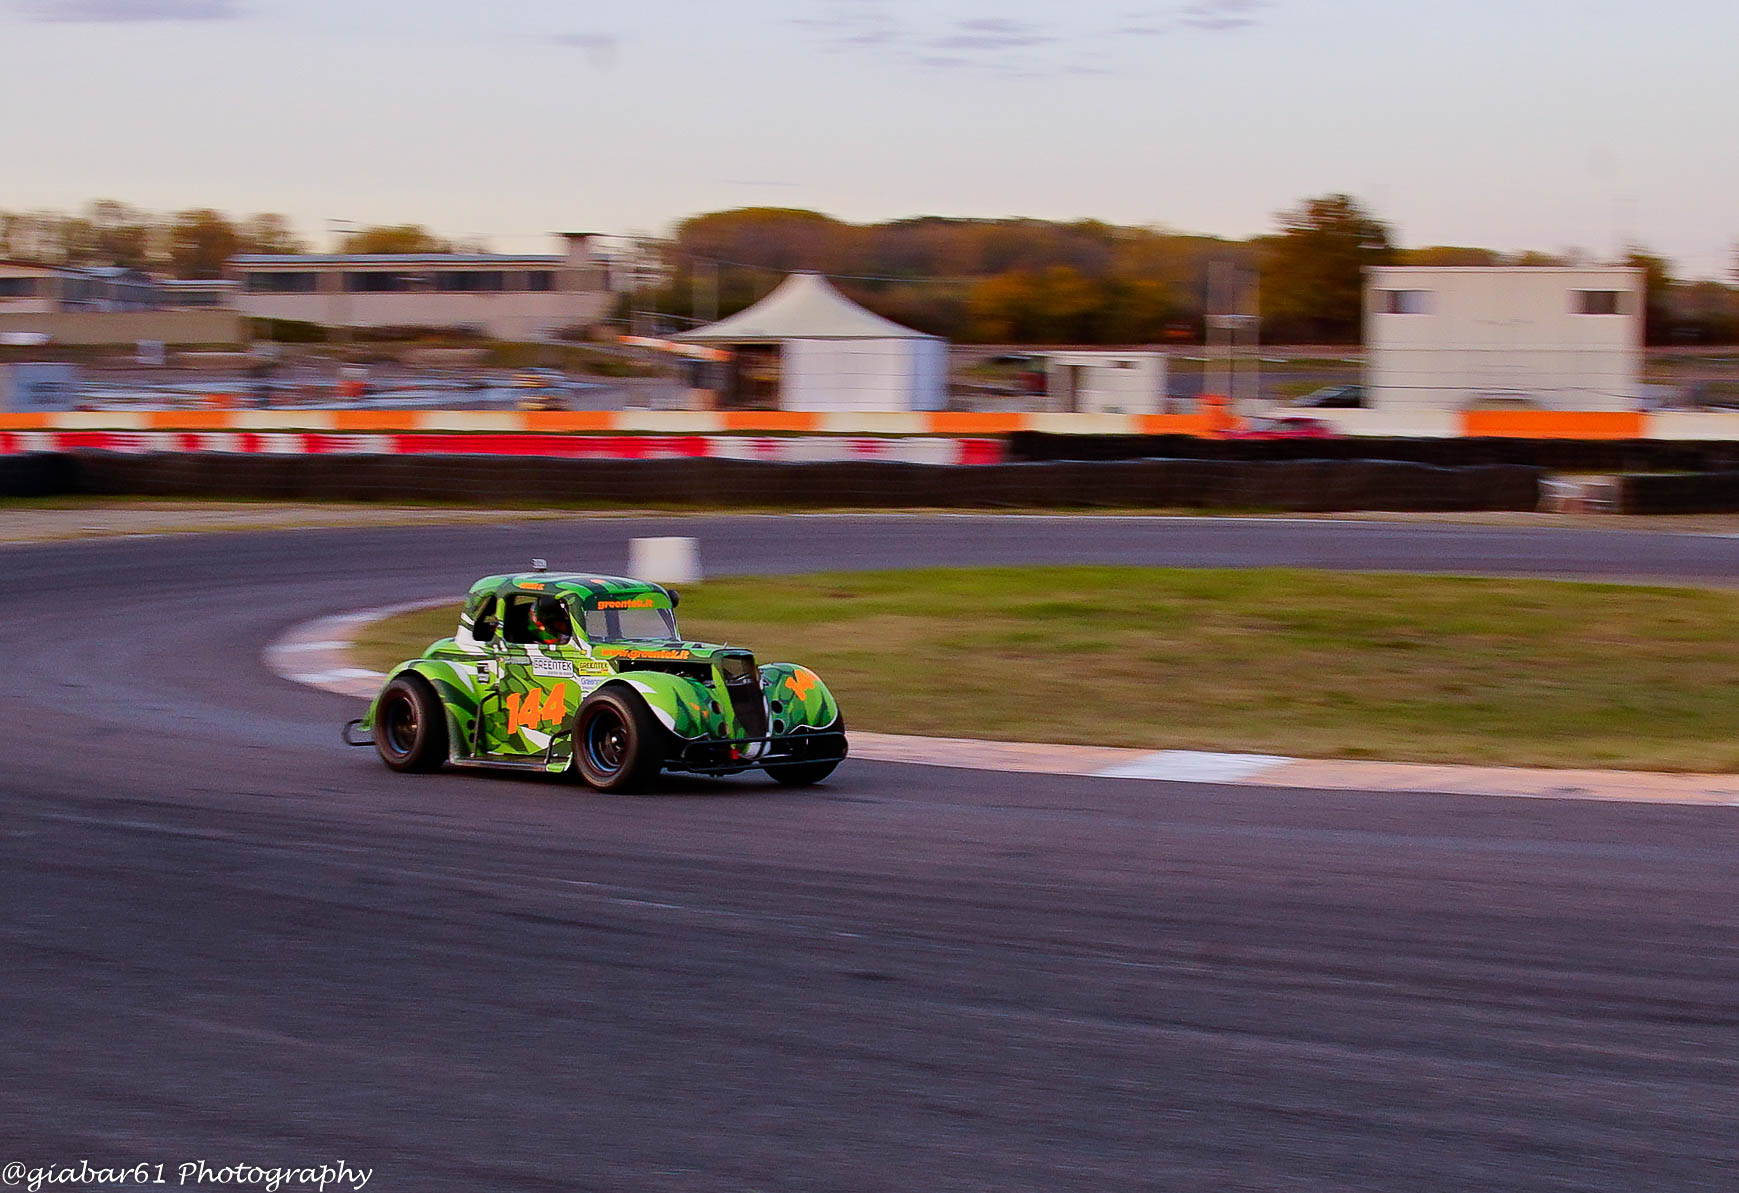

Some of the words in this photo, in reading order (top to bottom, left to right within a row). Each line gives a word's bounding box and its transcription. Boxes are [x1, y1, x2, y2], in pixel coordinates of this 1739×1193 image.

[597, 599, 653, 610] greentek.it
[601, 648, 690, 659] www.greentek.it
[533, 660, 572, 671] GREENTEK
[506, 682, 566, 735] 144
